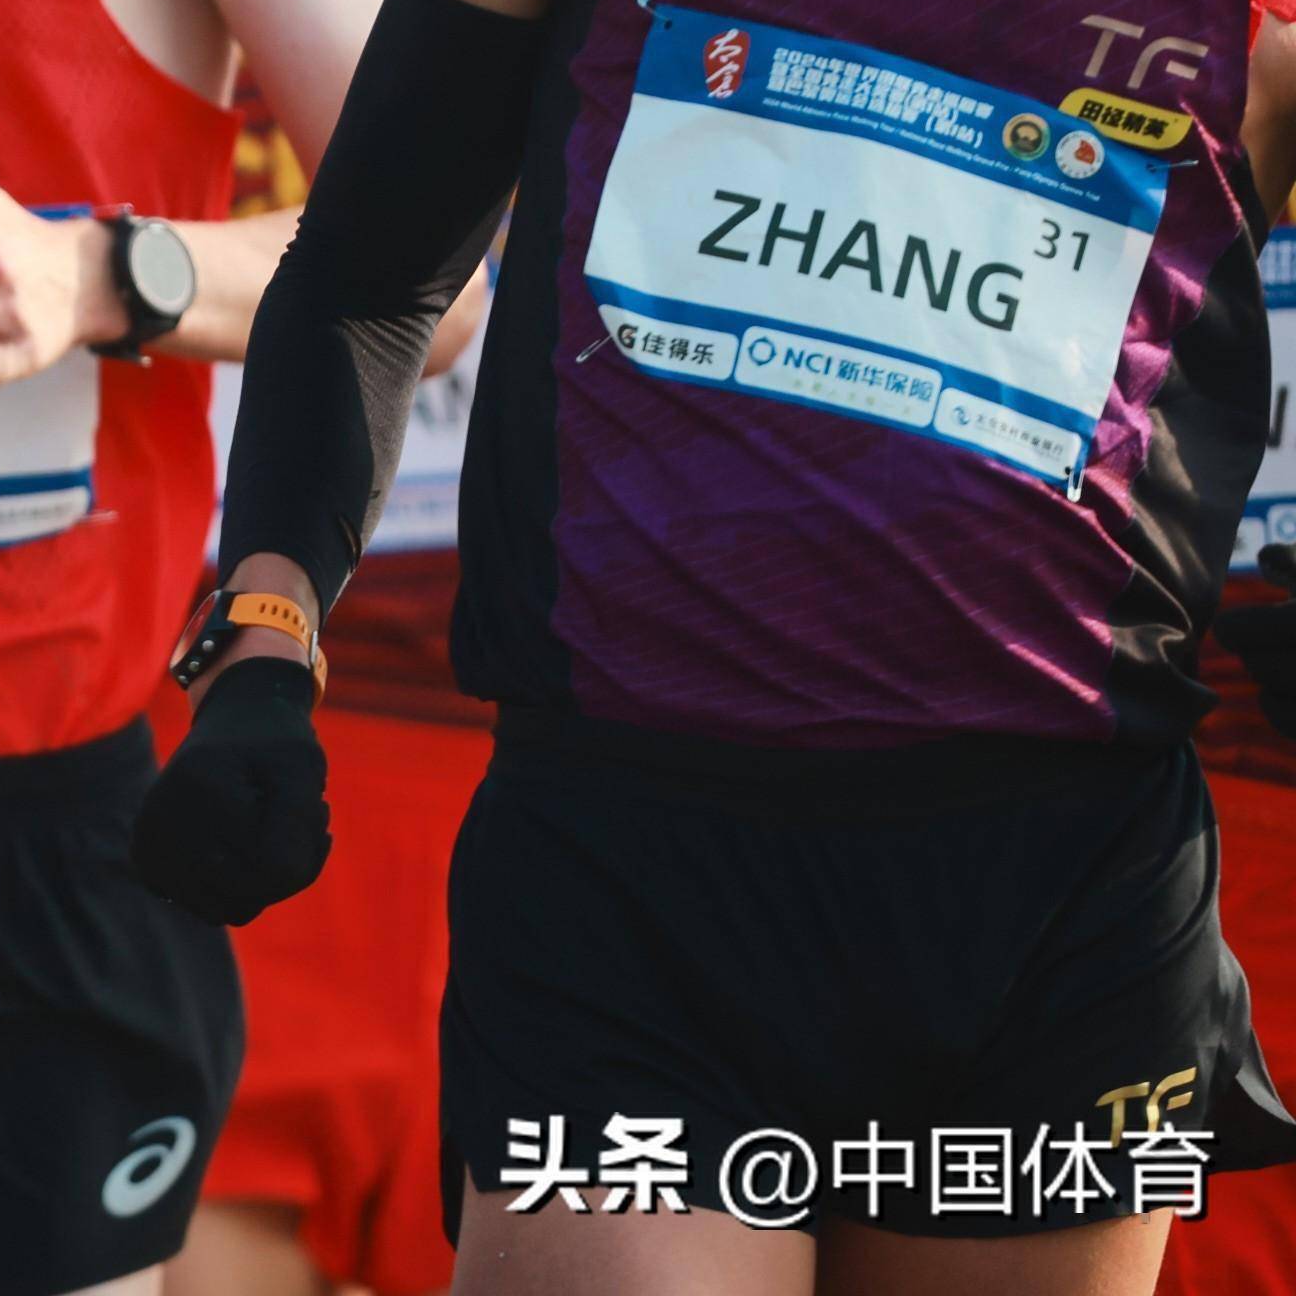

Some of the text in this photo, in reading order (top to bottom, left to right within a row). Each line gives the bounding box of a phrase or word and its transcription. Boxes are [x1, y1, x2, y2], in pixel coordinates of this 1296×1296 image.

[1080, 14, 1209, 90] TF
[1078, 99, 1169, 140] 田径精英
[698, 189, 1024, 332] ZHANG
[1033, 218, 1090, 272] 31
[641, 331, 715, 365] 佳得乐
[783, 347, 832, 375] NCI
[837, 358, 934, 402] 新华保险
